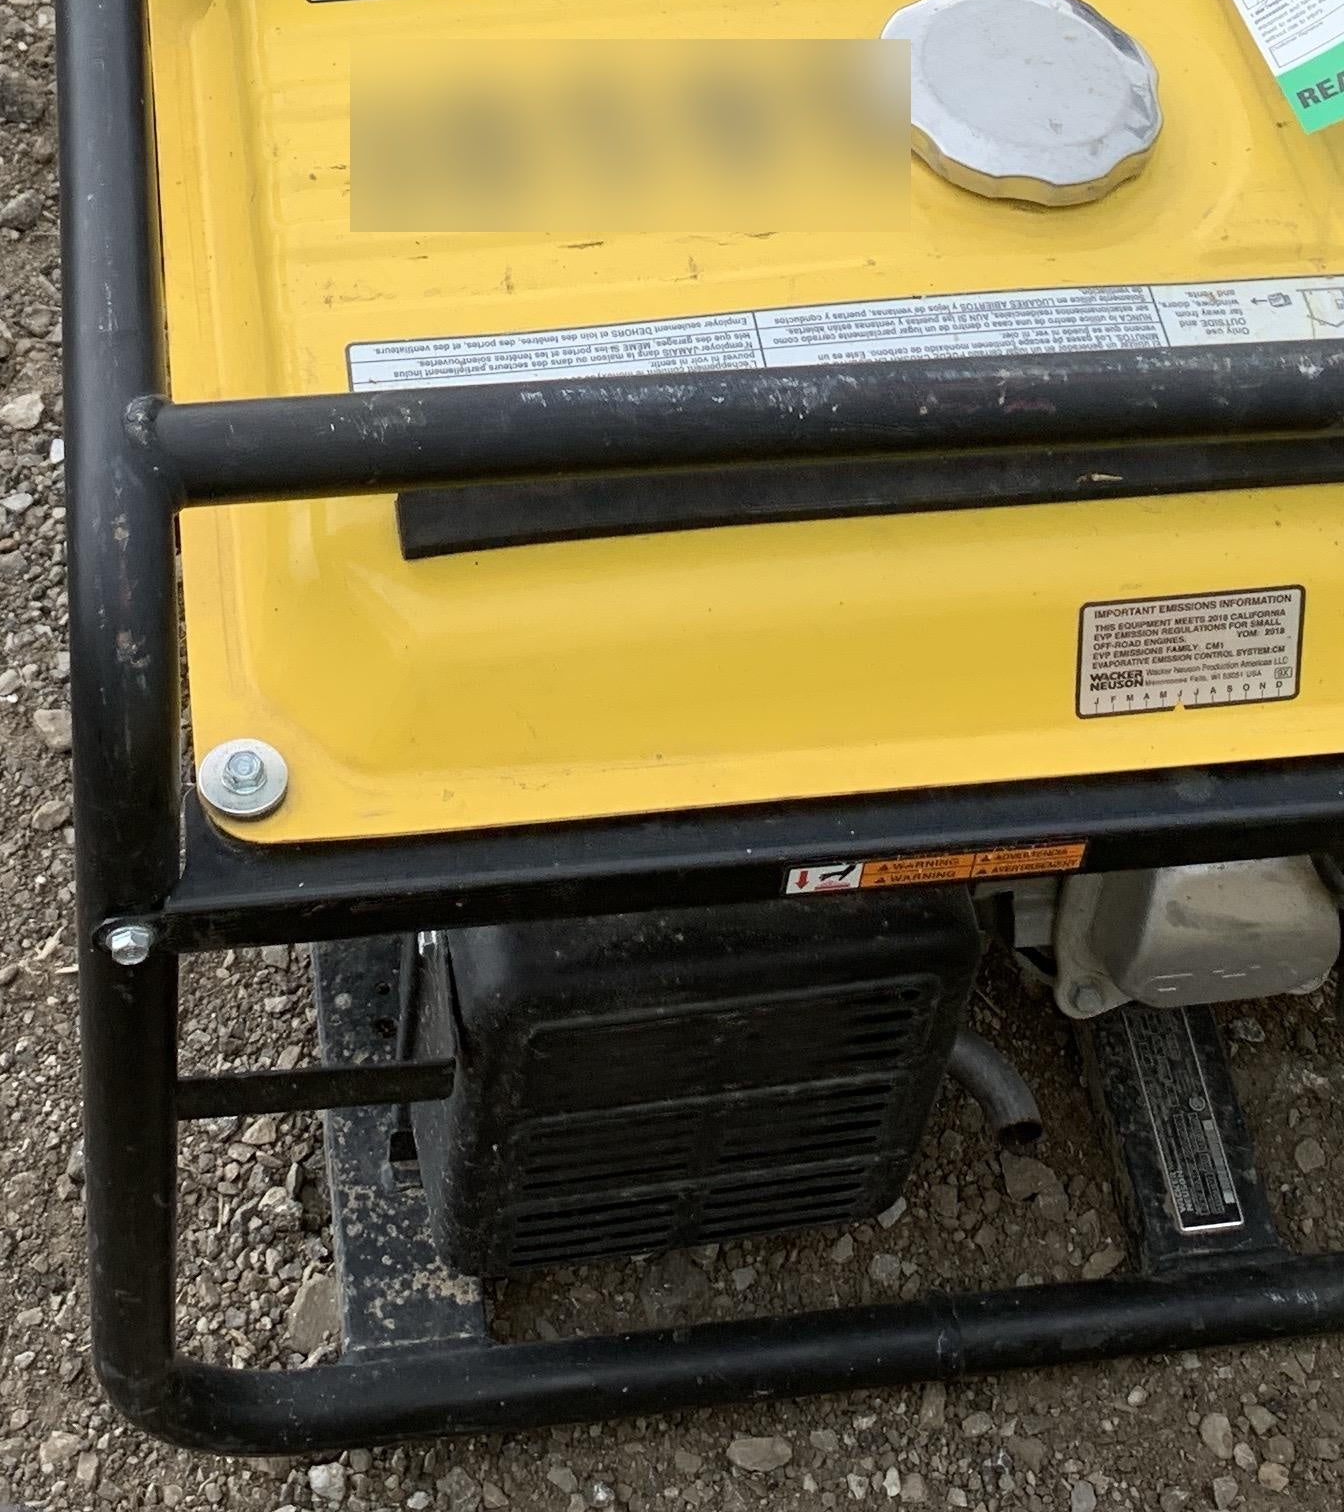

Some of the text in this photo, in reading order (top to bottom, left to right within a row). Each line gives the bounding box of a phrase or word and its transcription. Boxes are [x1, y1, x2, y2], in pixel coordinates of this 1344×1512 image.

[1090, 670, 1142, 681] WACKER
[1090, 679, 1142, 690] NEUSON
[892, 858, 960, 870] WARNING
[890, 871, 956, 882] WARNING
